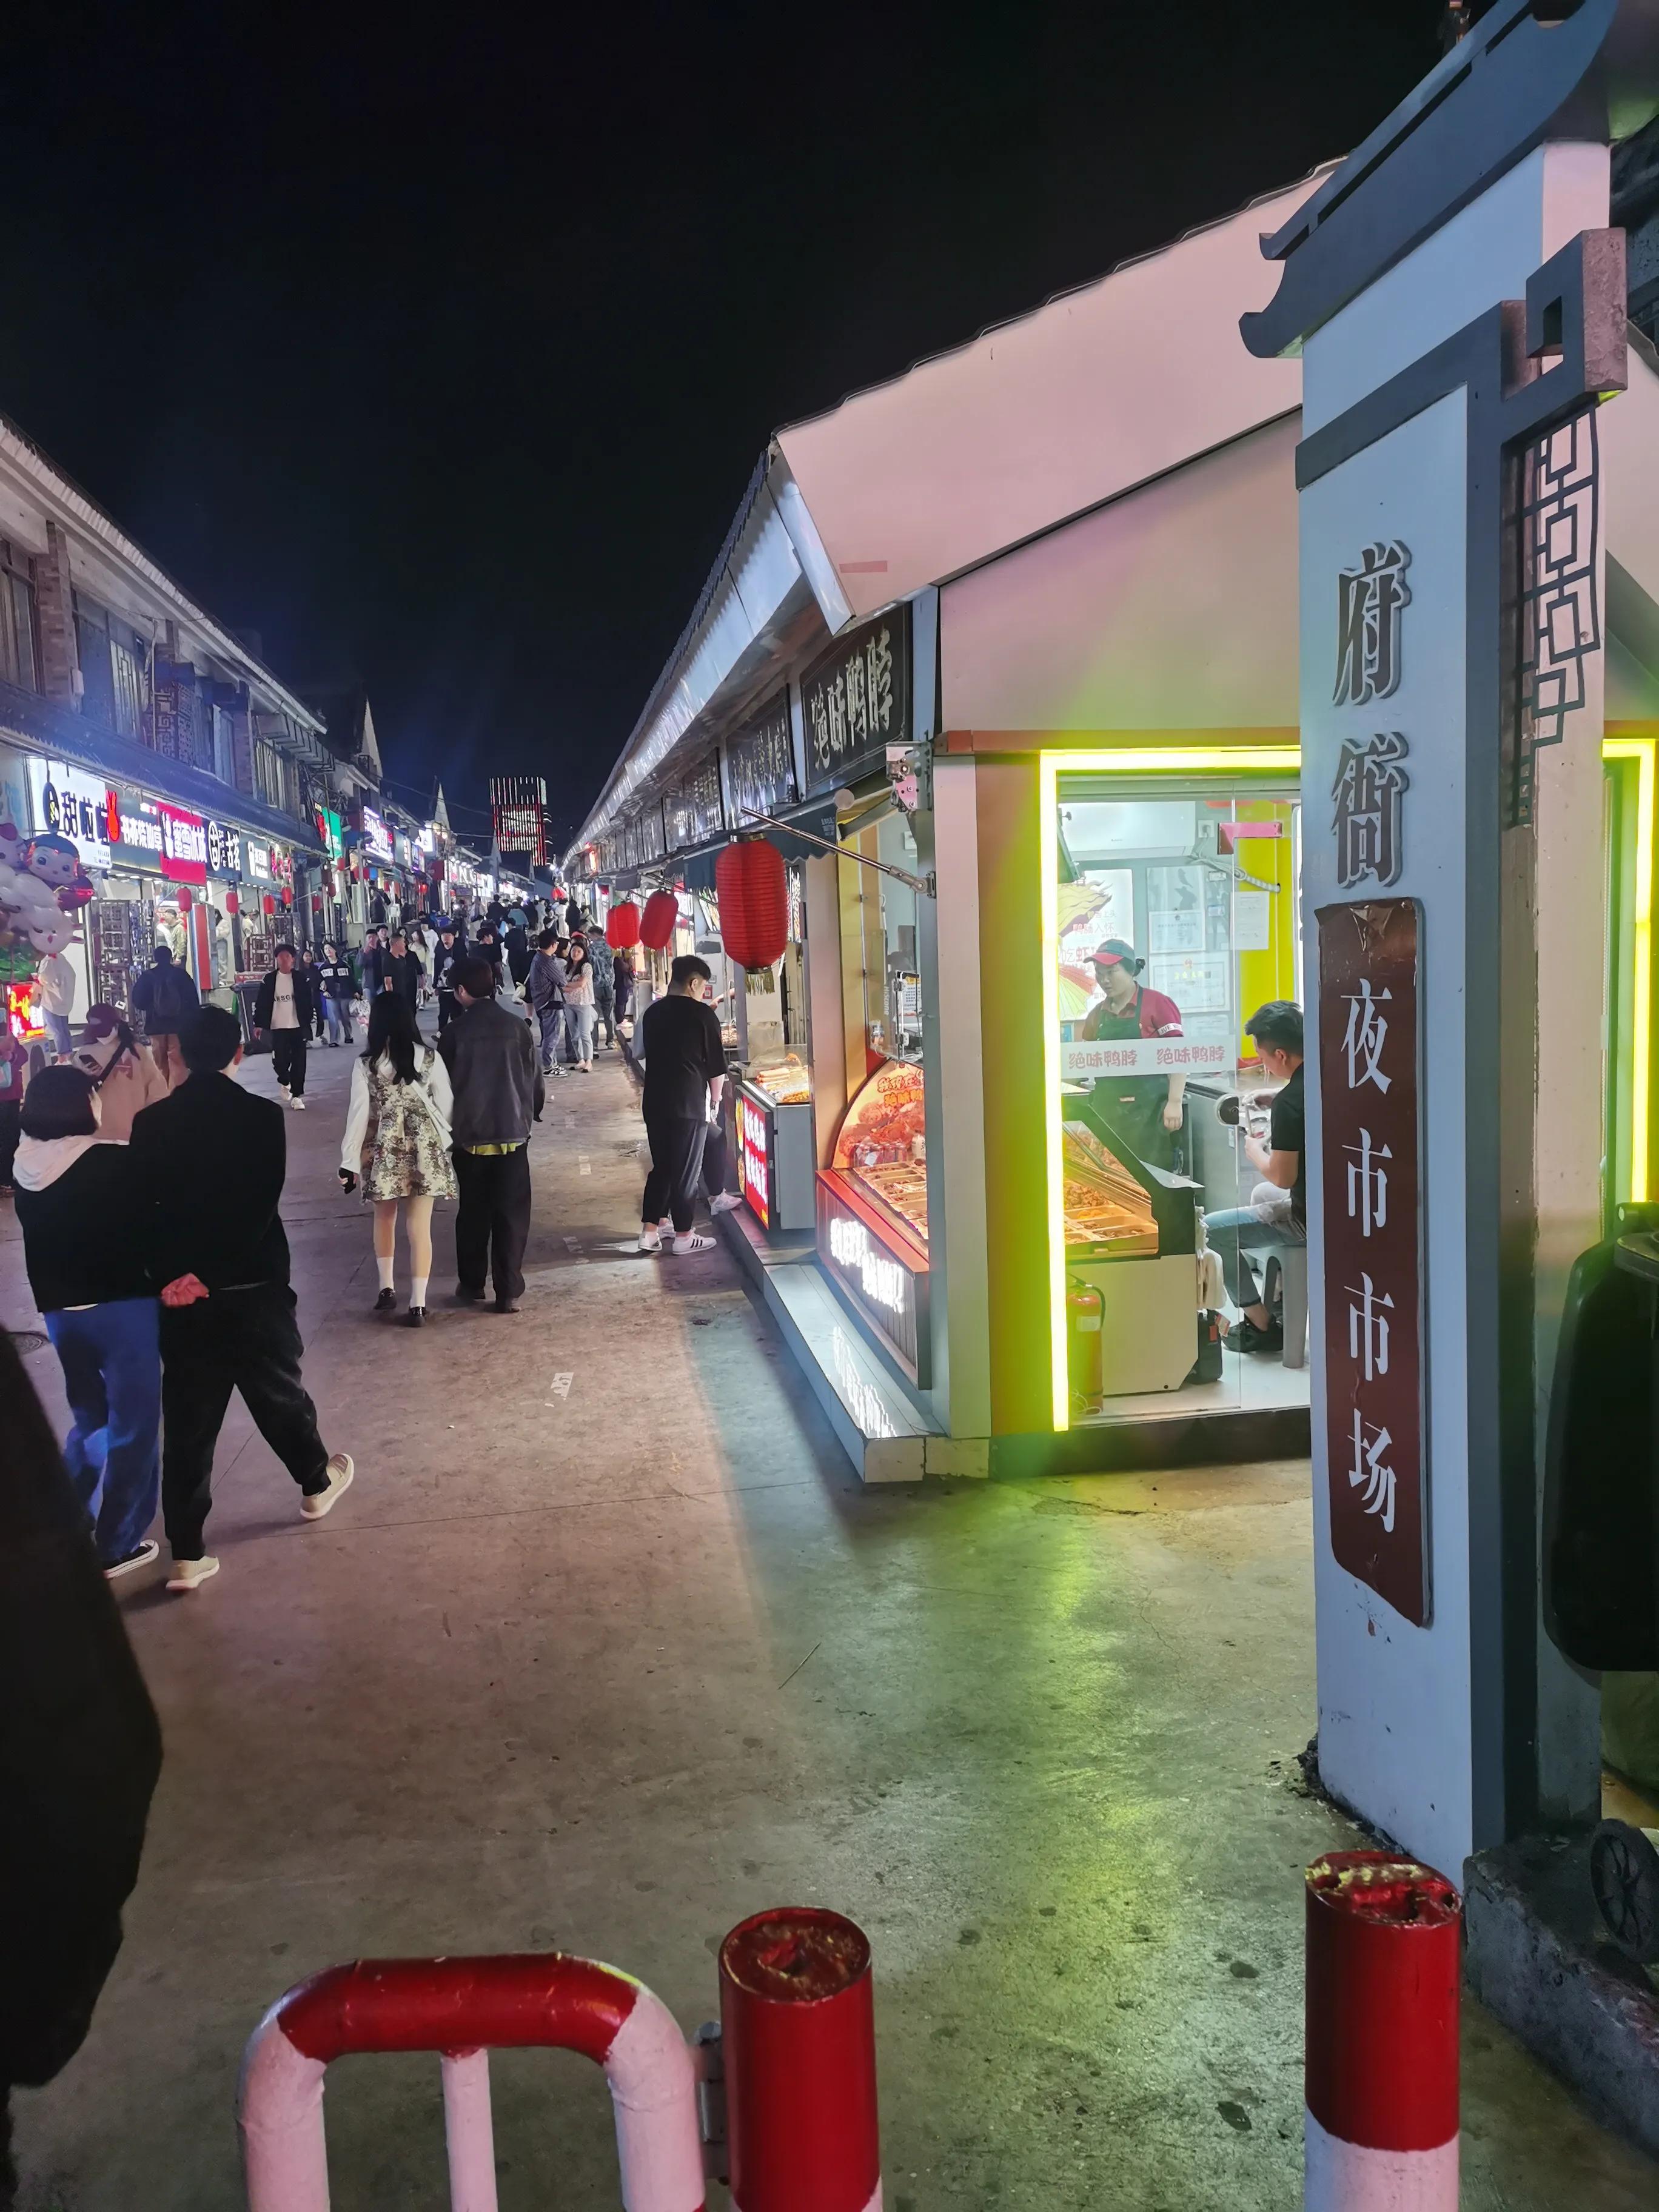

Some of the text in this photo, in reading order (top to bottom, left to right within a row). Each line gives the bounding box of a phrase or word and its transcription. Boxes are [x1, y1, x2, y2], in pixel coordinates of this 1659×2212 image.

[811, 623, 893, 771] 绝味鸭脖
[1332, 539, 1412, 888] 府衙
[120, 814, 163, 851] 书亦烧仙草
[172, 819, 207, 863] 蜜雪冰城
[226, 830, 241, 871] 古茗
[1068, 1045, 1225, 1070] 绝味鸭脖 绝味鸭脖
[1340, 977, 1397, 1533] 夜市市场
